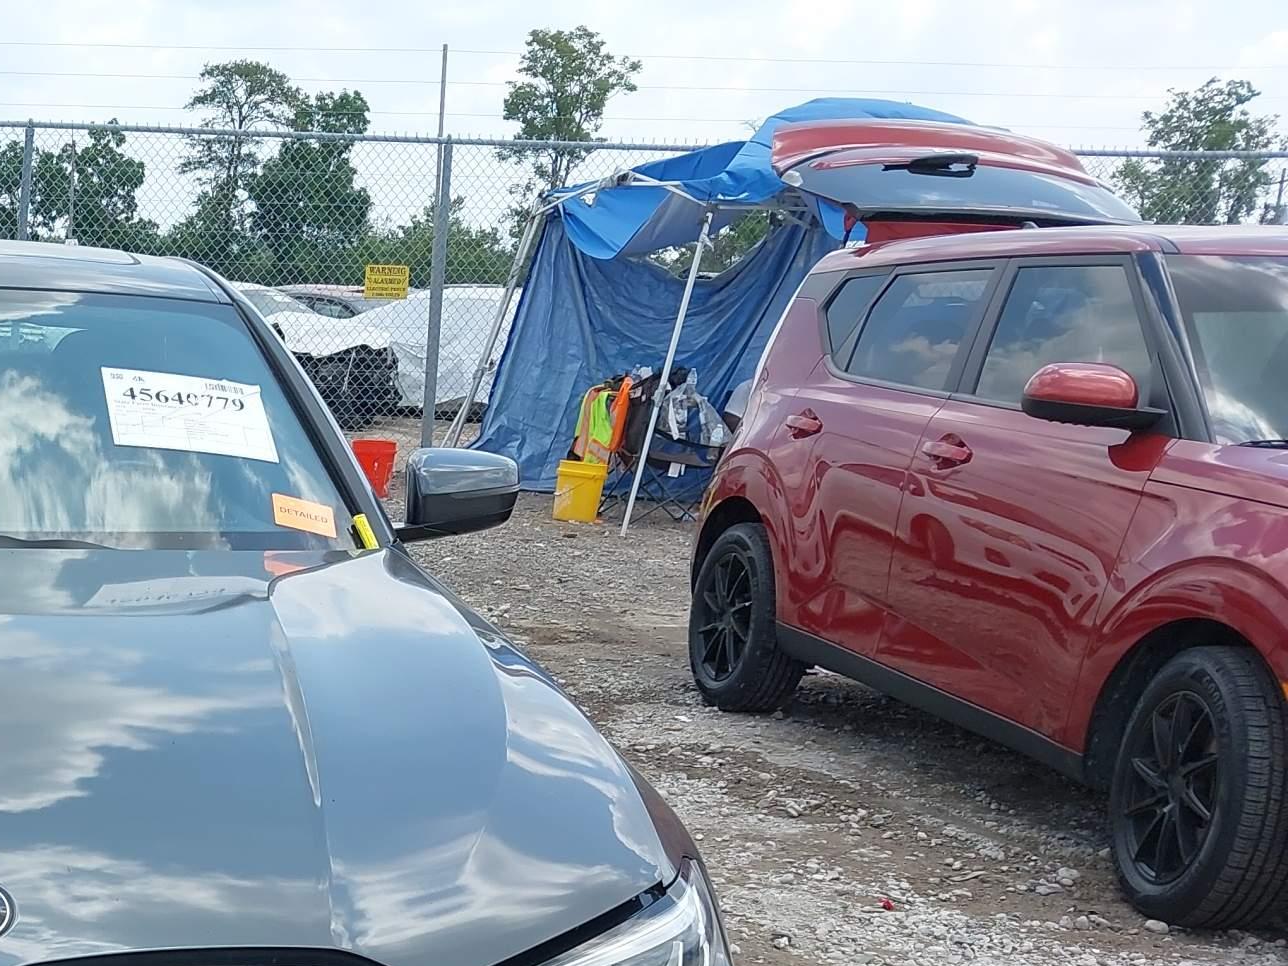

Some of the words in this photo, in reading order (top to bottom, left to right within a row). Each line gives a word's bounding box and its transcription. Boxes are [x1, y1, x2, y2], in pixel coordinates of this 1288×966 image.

[369, 266, 406, 275] WARNING
[122, 387, 245, 411] 45640779
[279, 506, 329, 524] DETAILED
